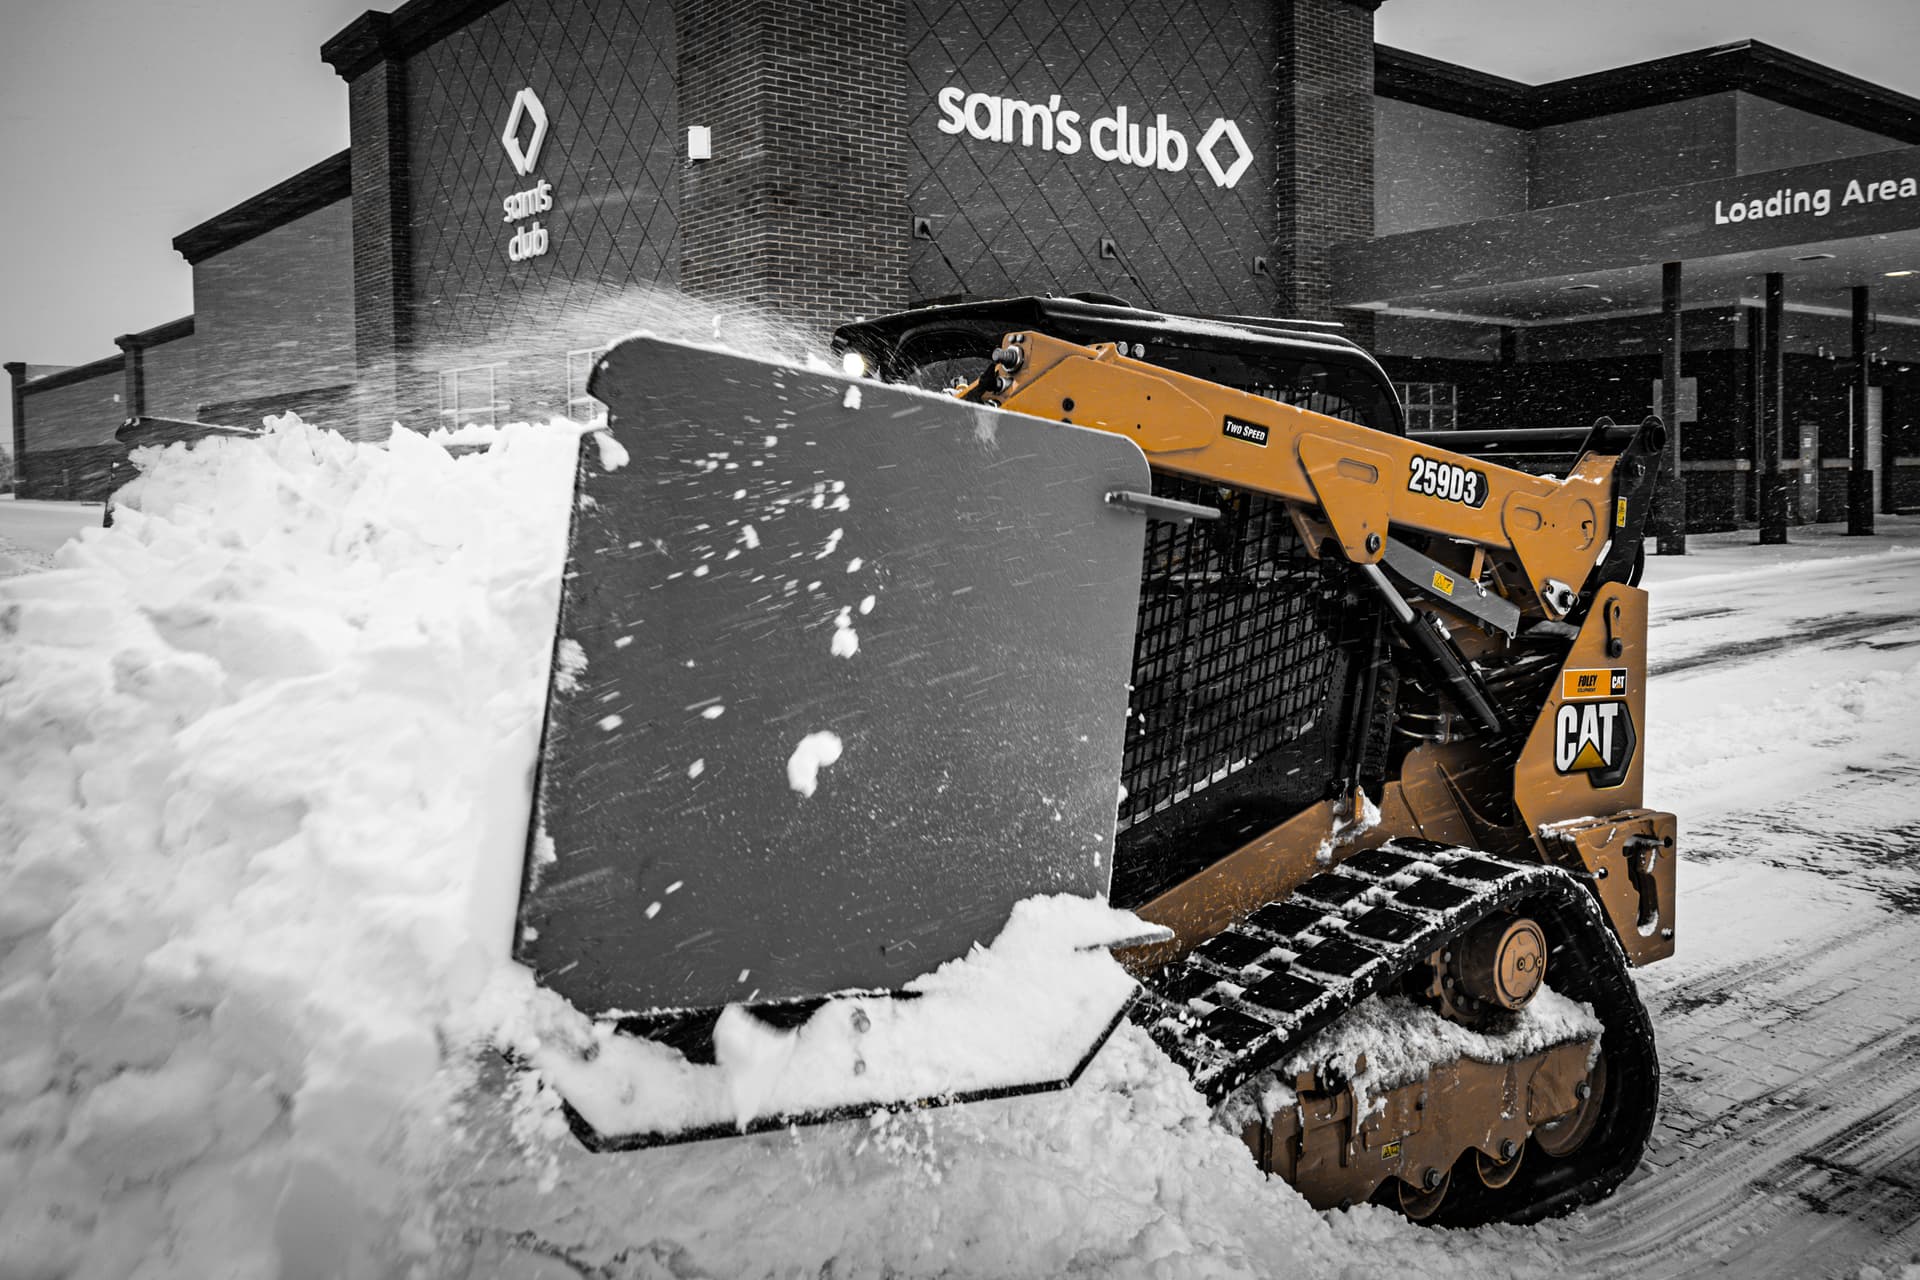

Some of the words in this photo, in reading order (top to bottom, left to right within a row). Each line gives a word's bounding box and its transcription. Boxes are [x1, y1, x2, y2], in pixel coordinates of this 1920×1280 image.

[937, 87, 1082, 154] sam's
[1090, 106, 1188, 172] club
[1715, 188, 1831, 225] Loading
[1841, 177, 1917, 206] Area
[509, 221, 549, 262] club
[1409, 457, 1478, 505] 259D3
[1577, 674, 1598, 687] FOLEY
[1611, 676, 1625, 689] CAT
[1556, 702, 1619, 772] CAT
